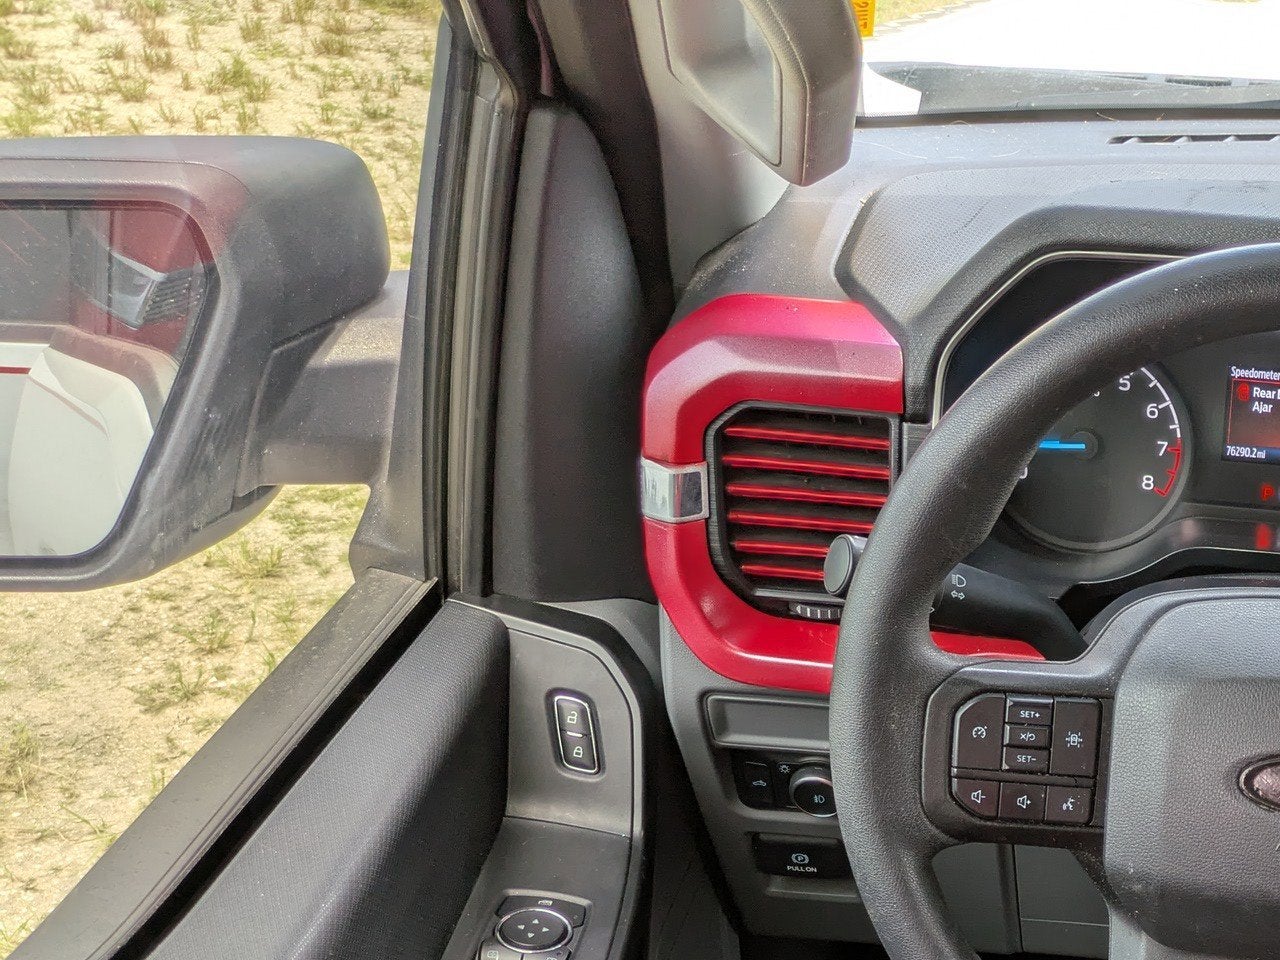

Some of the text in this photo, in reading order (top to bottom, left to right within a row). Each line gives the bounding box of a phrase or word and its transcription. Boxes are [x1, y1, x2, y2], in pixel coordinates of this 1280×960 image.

[1230, 366, 1280, 381] Speedometer
[1118, 375, 1131, 391] 5
[1253, 387, 1276, 400] Rear
[1146, 404, 1159, 419] 6
[1252, 401, 1273, 414] Ajar
[1157, 441, 1168, 456] 7
[1142, 475, 1154, 490] 8
[1262, 484, 1274, 500] P
